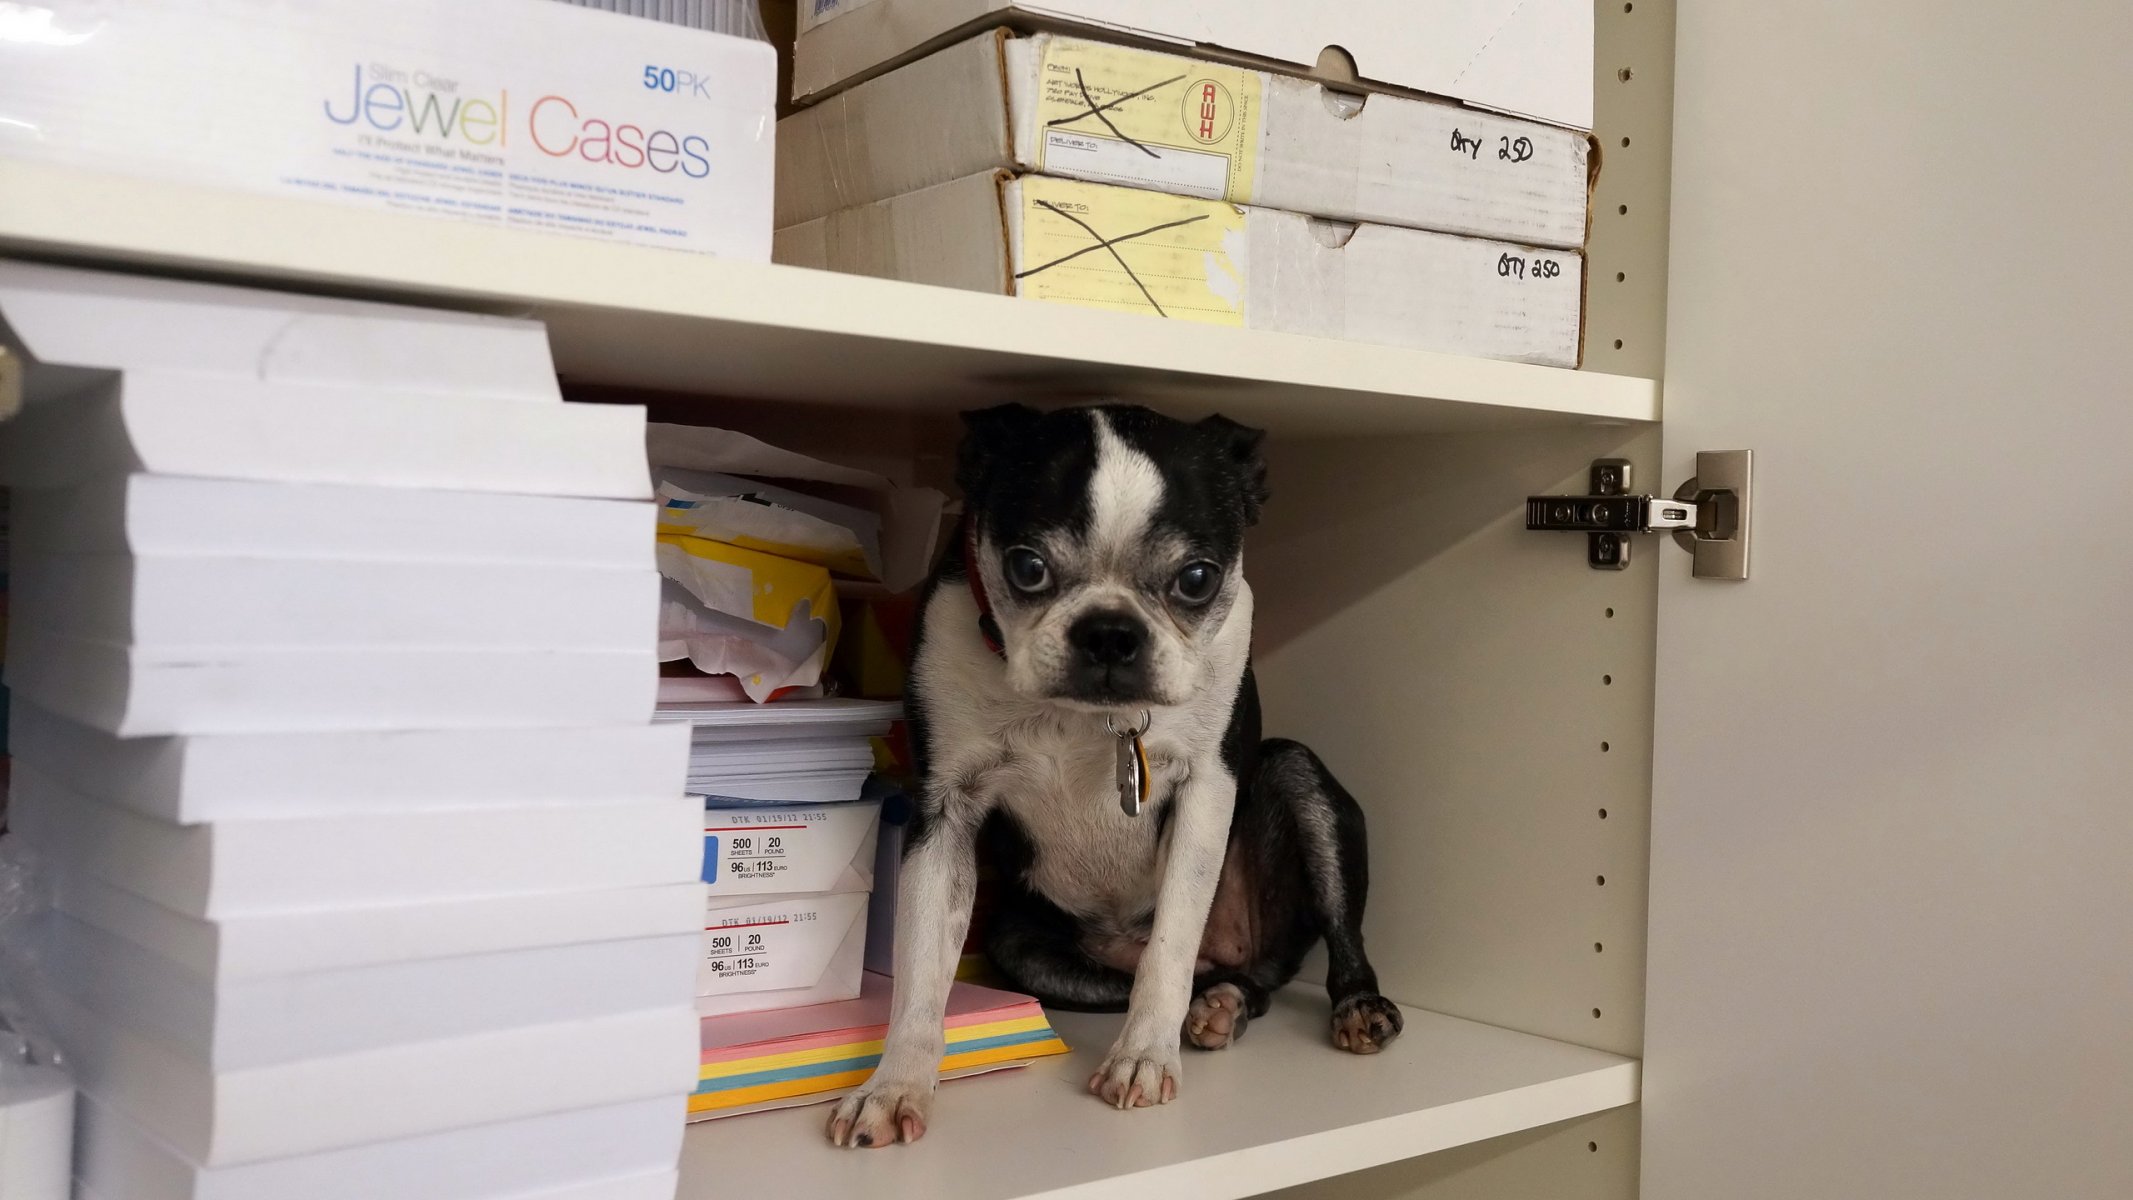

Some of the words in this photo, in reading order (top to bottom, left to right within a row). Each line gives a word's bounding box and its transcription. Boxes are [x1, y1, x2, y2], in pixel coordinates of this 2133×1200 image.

[369, 62, 409, 83] Slim
[413, 70, 459, 93] Clear
[324, 64, 507, 148] Jewel
[530, 95, 710, 179] Cases
[1050, 136, 1085, 147] DELIVER
[1451, 128, 1482, 160] QTY
[1499, 136, 1533, 163] 250
[1498, 252, 1525, 280] QTY
[1532, 259, 1560, 279] 250
[731, 816, 750, 824] DTK
[802, 812, 827, 821] 21:55
[732, 838, 751, 849] 500
[768, 837, 781, 848] 20
[731, 862, 744, 873] 96
[756, 860, 773, 872] 113
[722, 918, 739, 927] DTK
[793, 912, 817, 922] 21:55
[712, 936, 731, 948] 500
[748, 934, 761, 945] 20
[710, 947, 732, 955] SHEETS
[711, 960, 724, 972] 96
[737, 958, 754, 969] 113
